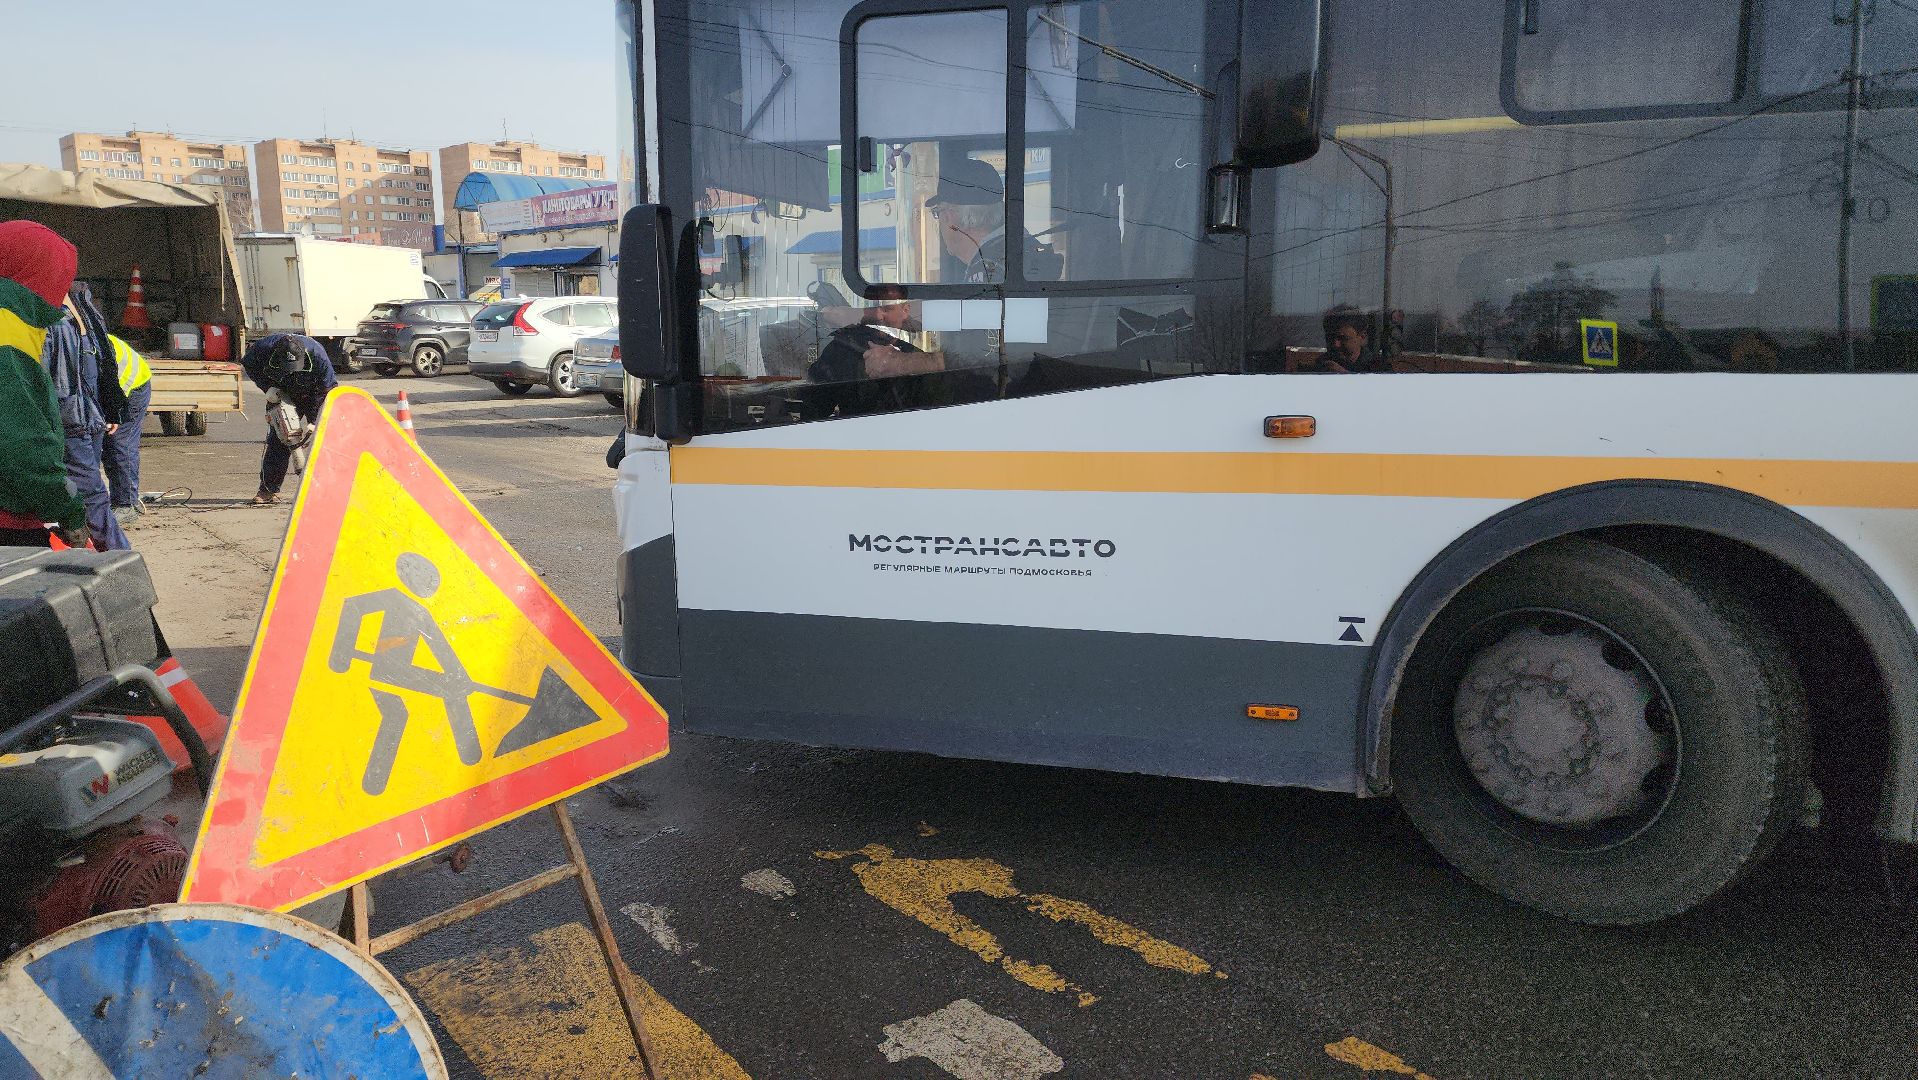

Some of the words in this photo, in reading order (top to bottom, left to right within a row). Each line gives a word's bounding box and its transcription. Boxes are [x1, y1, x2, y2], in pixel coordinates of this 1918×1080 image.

[848, 534, 1117, 558] МОСТРАНСАВТО
[873, 563, 942, 573] РЕГУЛЯРНЫЕ
[944, 566, 1006, 575] МАРШРУТЫ
[1009, 567, 1093, 577] ПОДМОСКОВЬЯ
